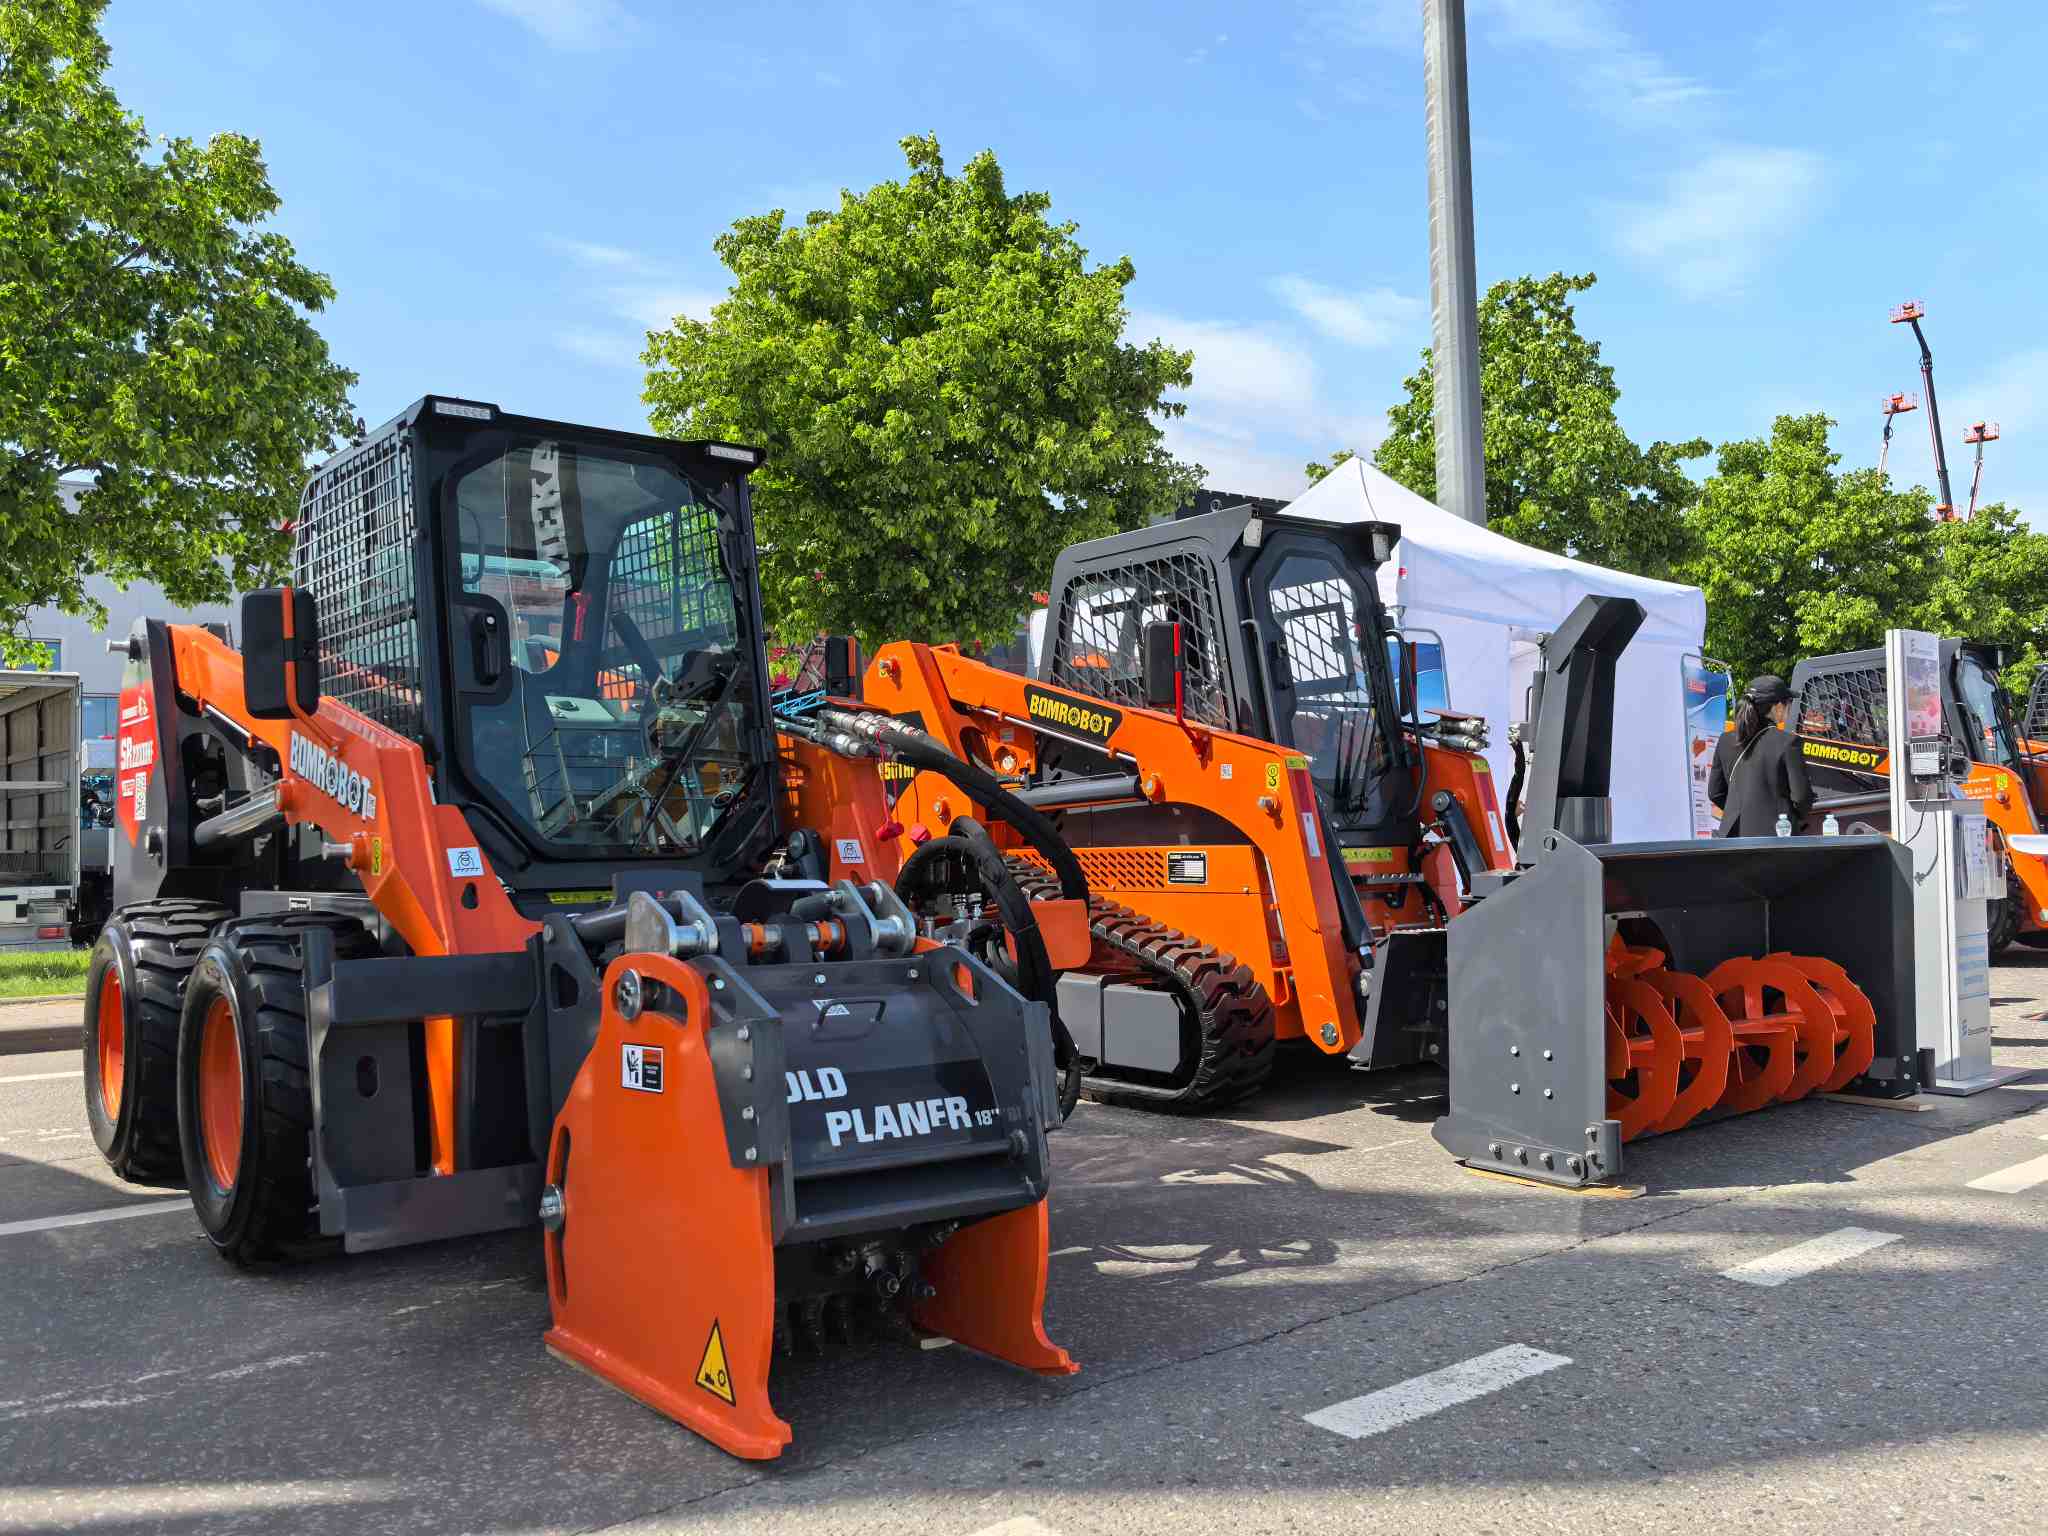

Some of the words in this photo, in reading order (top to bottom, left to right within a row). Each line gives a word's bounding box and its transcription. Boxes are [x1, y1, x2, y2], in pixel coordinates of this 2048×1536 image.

[1029, 694, 1112, 737] BOMROBOT
[291, 730, 371, 820] BOMROBOT
[1803, 741, 1880, 767] BOMROBOT
[825, 1096, 973, 1147] PLANER
